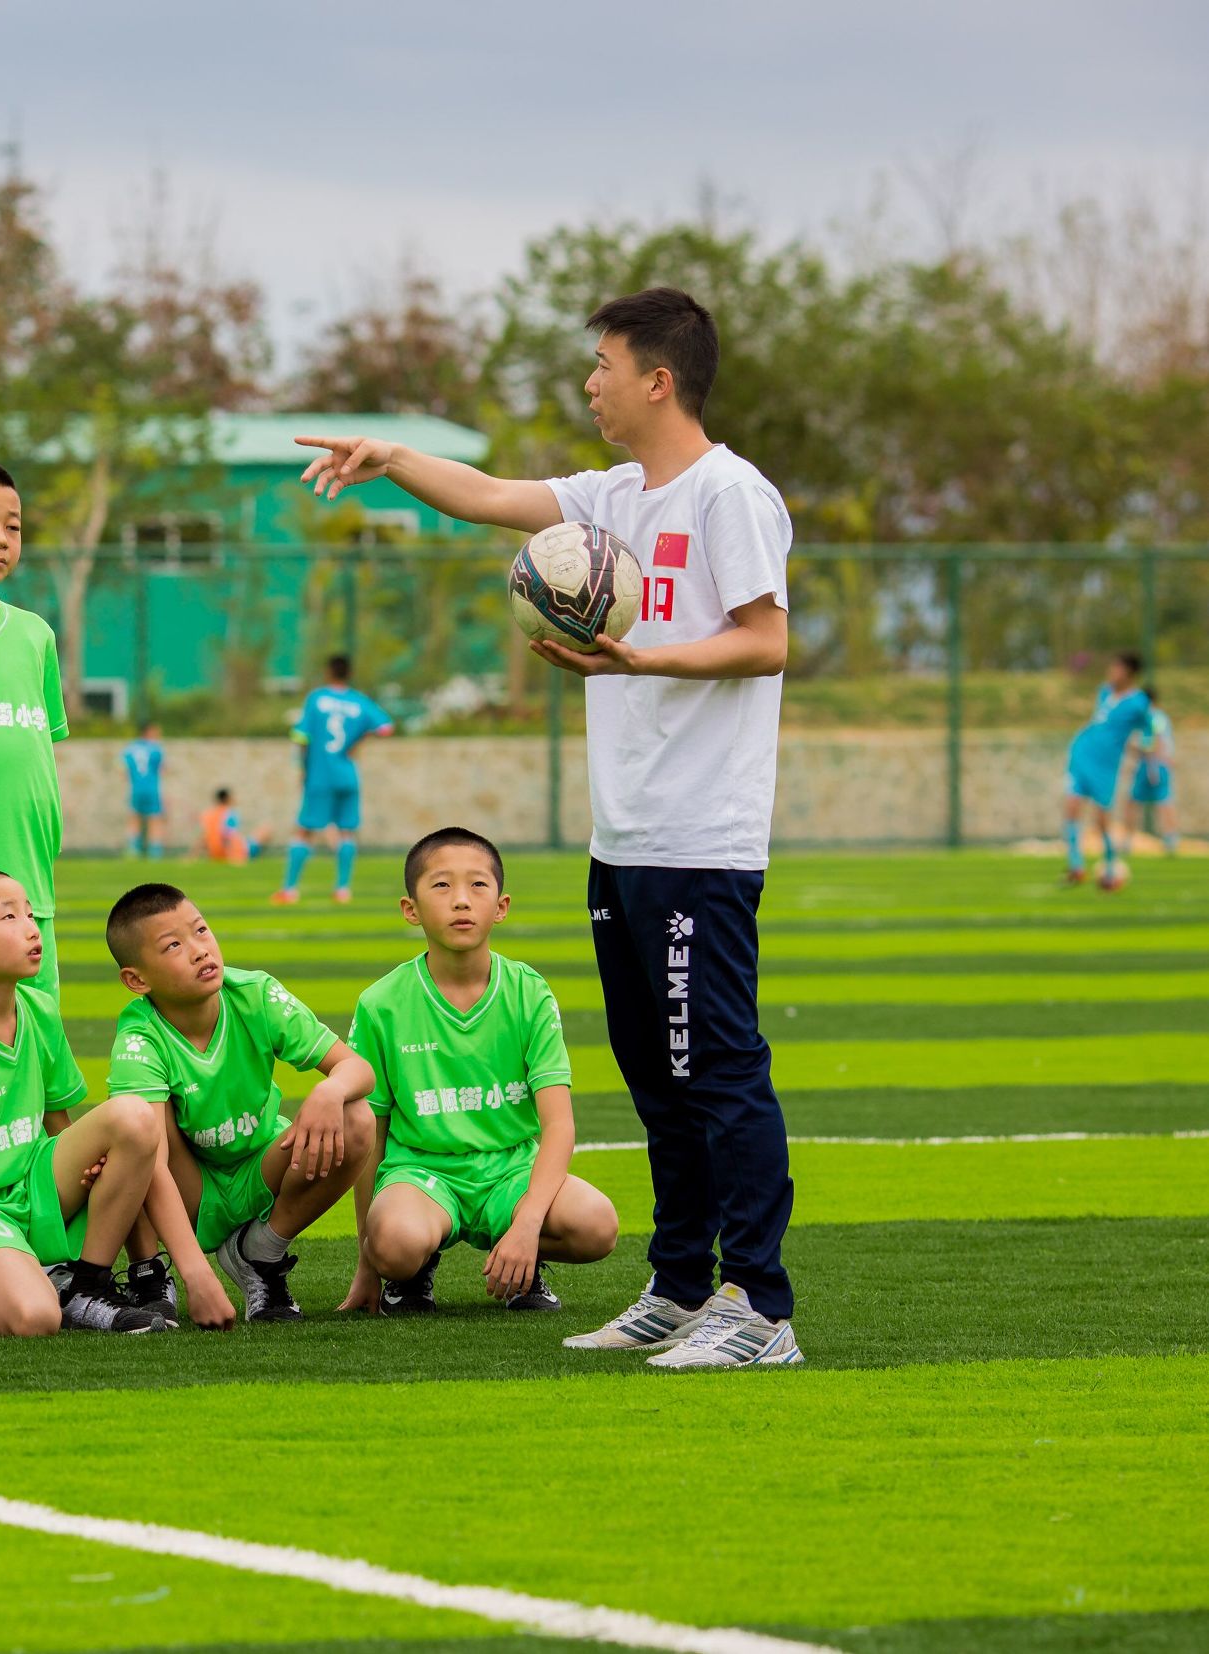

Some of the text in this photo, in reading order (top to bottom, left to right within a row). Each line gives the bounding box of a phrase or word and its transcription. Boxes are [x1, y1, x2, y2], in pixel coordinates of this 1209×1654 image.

[667, 945, 690, 1077] KELME
[401, 1042, 438, 1054] KELME
[116, 1053, 149, 1064] KELME
